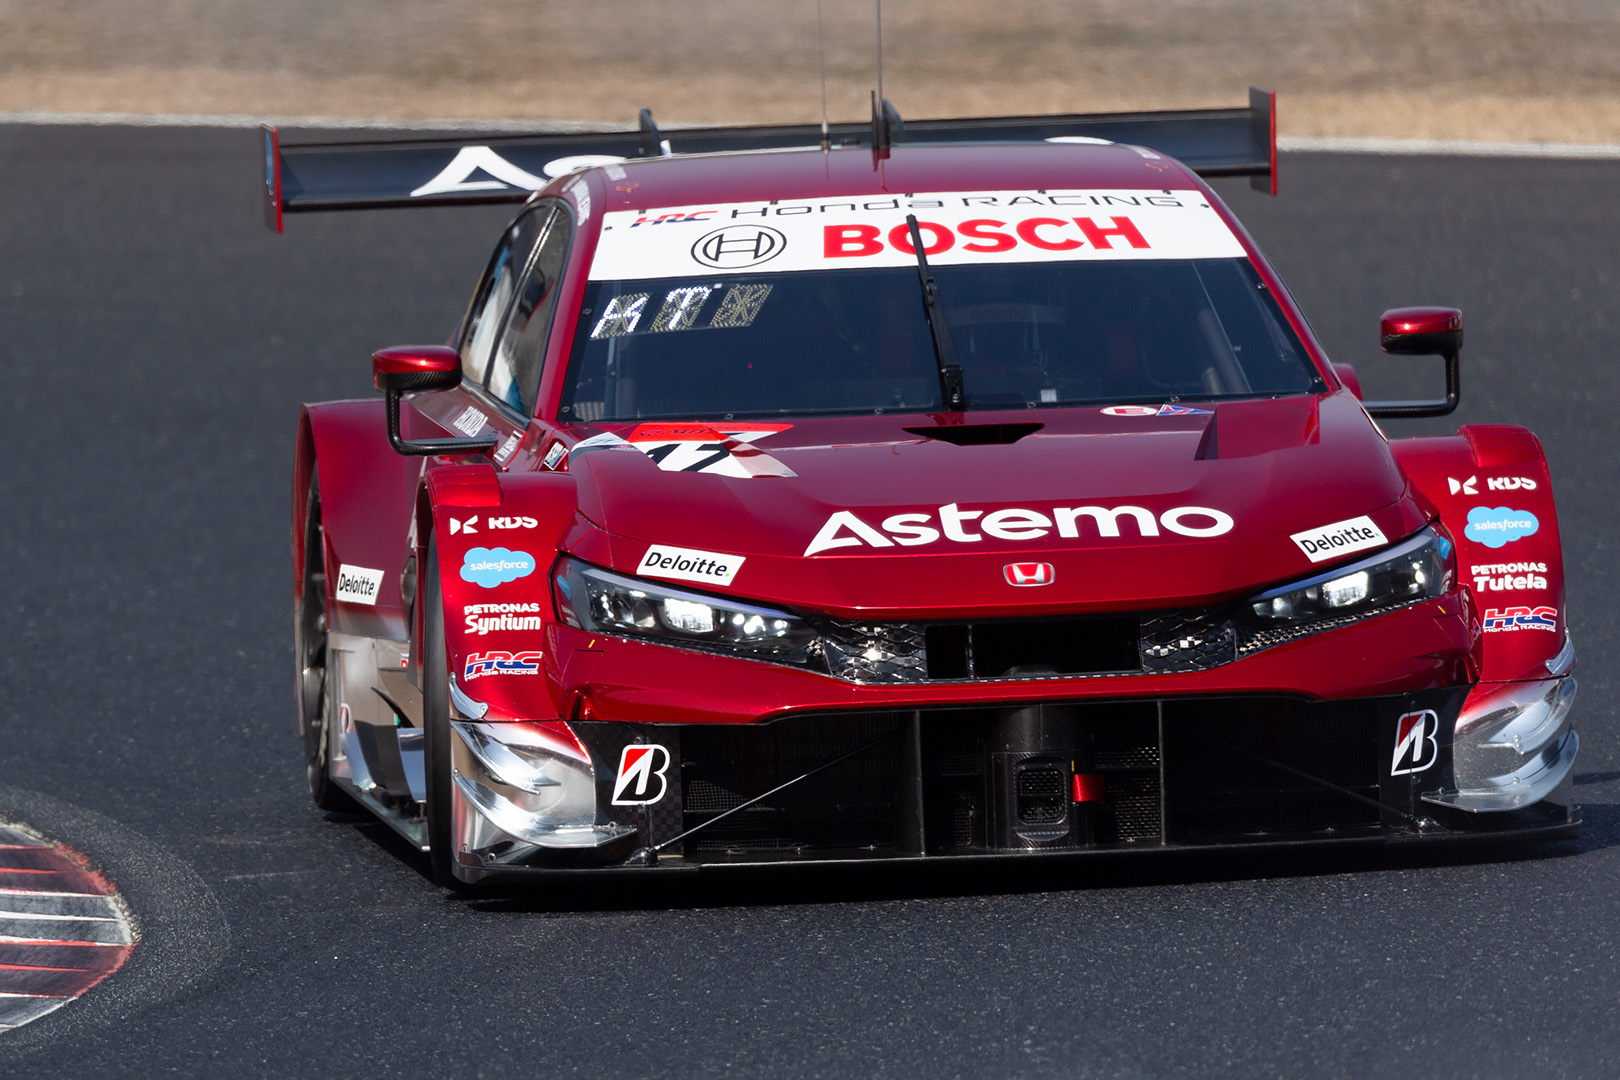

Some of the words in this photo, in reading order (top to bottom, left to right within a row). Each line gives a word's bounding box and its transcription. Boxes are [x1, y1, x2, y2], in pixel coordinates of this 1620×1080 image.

[731, 199, 944, 219] Honda
[961, 195, 1184, 207] RACING
[823, 215, 1152, 259] BOSCH
[803, 502, 1234, 558] Astemo
[1474, 519, 1532, 532] salesforce
[470, 559, 529, 572] salesforce
[1471, 562, 1547, 576] PETRONAS
[1473, 573, 1547, 592] Tutela
[464, 602, 540, 615] PETRONAS
[1483, 606, 1558, 629] HRC
[464, 613, 541, 635] Syntium
[1520, 624, 1556, 633] RACING
[464, 651, 543, 676] HRC
[464, 670, 498, 682] Honda
